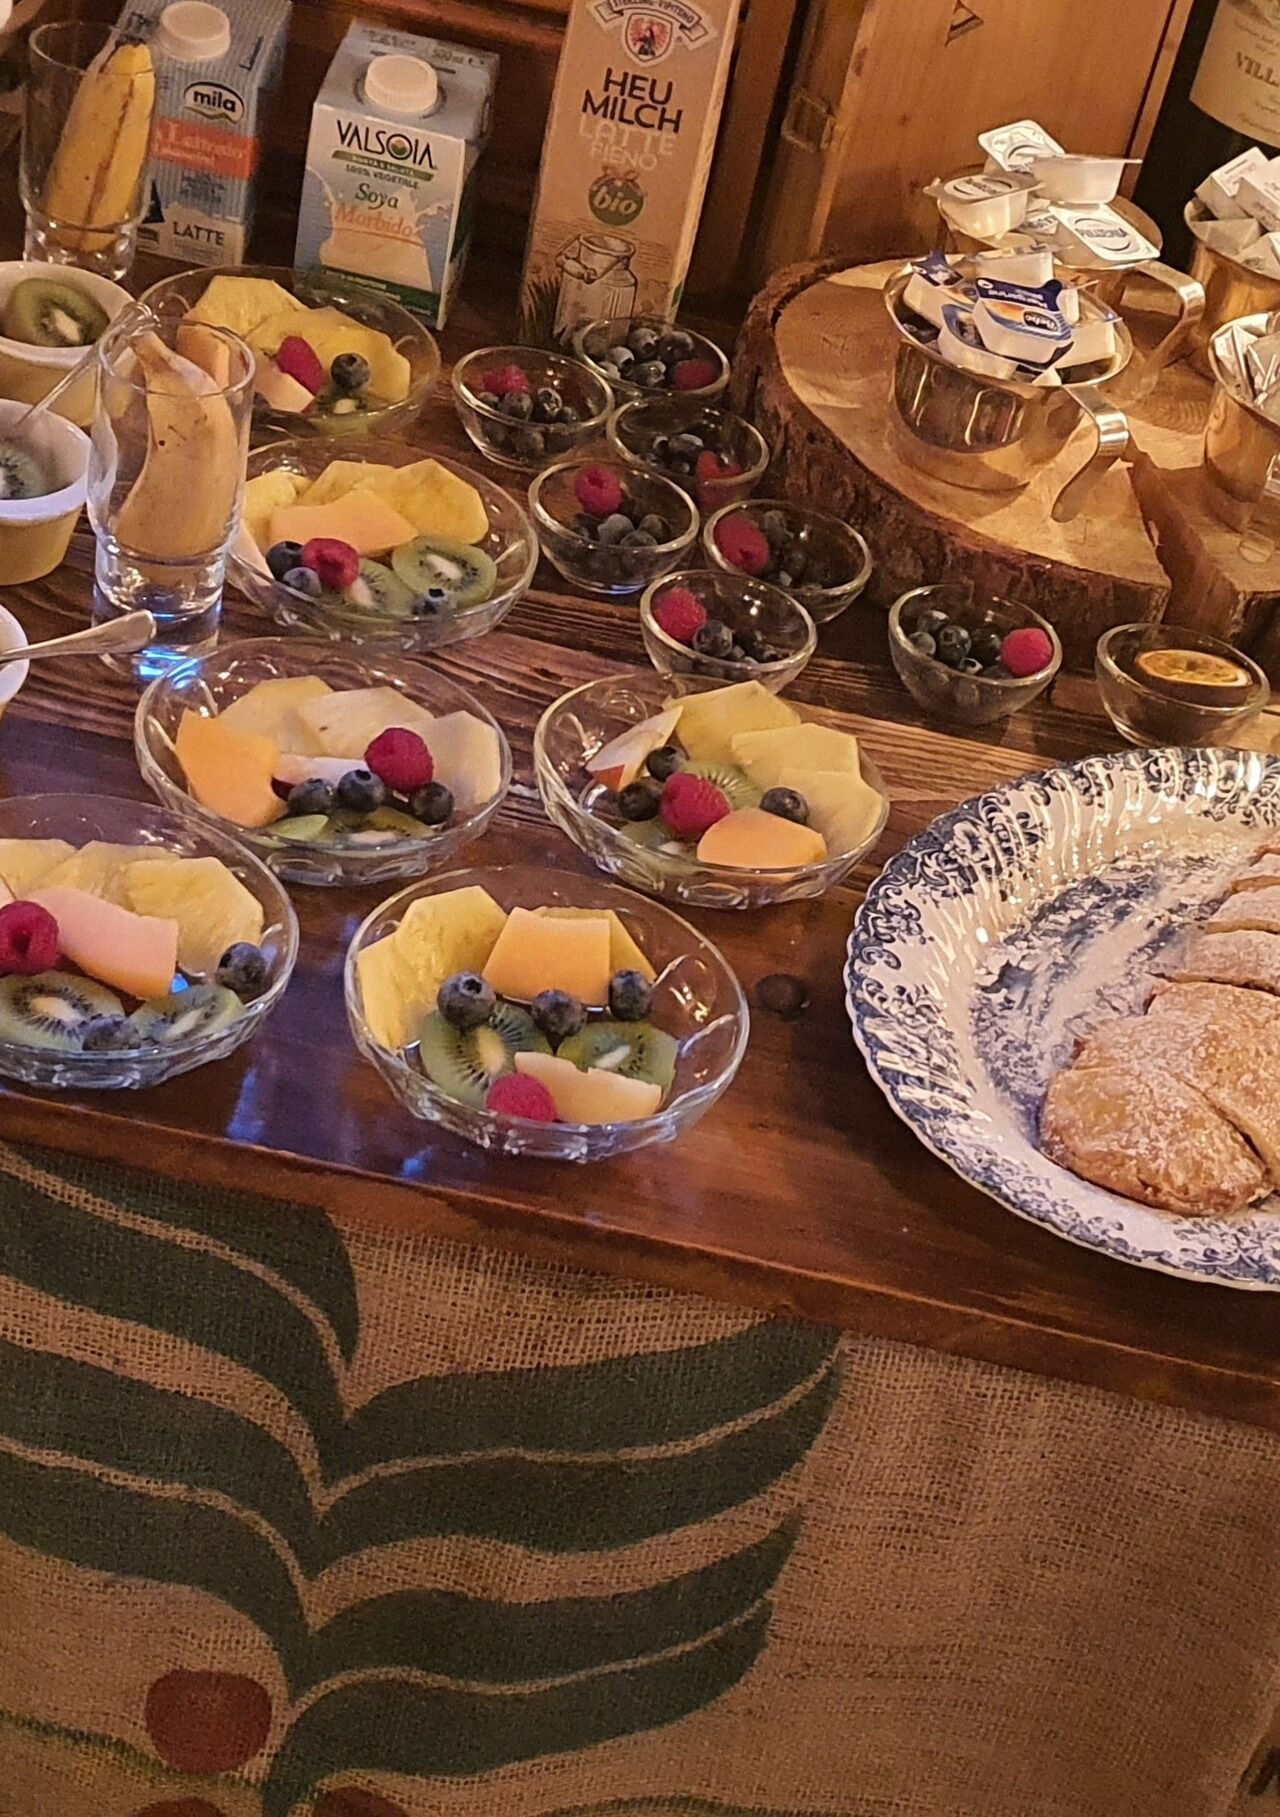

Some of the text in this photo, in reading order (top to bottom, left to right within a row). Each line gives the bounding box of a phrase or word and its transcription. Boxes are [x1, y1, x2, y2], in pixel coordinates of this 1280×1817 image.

[193, 89, 236, 113] mila
[603, 67, 673, 105] HEU
[581, 89, 684, 134] MILCH
[336, 119, 438, 170] VALSOIA
[578, 114, 677, 156] LATTE
[590, 140, 658, 171] FIENO
[354, 182, 400, 210] Soya
[593, 185, 638, 215] bio
[173, 221, 225, 247] LATTE
[334, 206, 414, 238] Morbido
